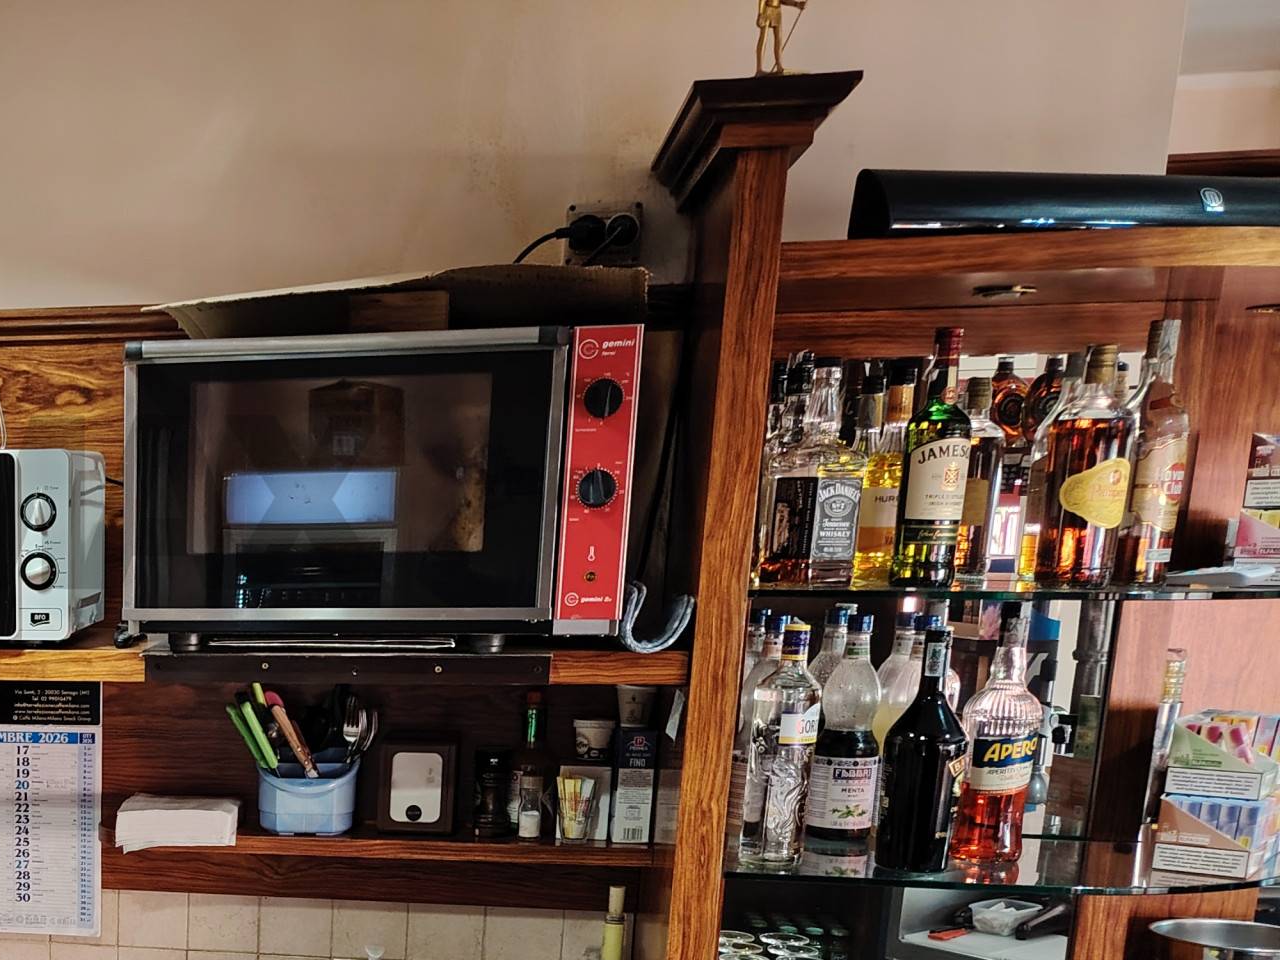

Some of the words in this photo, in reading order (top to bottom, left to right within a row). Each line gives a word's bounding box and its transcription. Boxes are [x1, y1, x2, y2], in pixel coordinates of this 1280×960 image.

[602, 339, 636, 350] gemini
[819, 485, 835, 502] JACK
[38, 733, 69, 744] 2026
[16, 746, 30, 754] 17
[16, 757, 30, 766] 18
[630, 758, 646, 767] FINO
[16, 768, 30, 778] 19
[15, 780, 30, 789] 20
[15, 792, 28, 801] 21
[15, 803, 30, 812] 22
[15, 814, 30, 824] 23
[15, 826, 29, 835] 24
[15, 837, 30, 846] 25
[15, 849, 30, 858] 26
[15, 860, 30, 869] 27
[15, 871, 30, 880] 28
[15, 882, 30, 891] 29
[15, 893, 30, 902] 30
